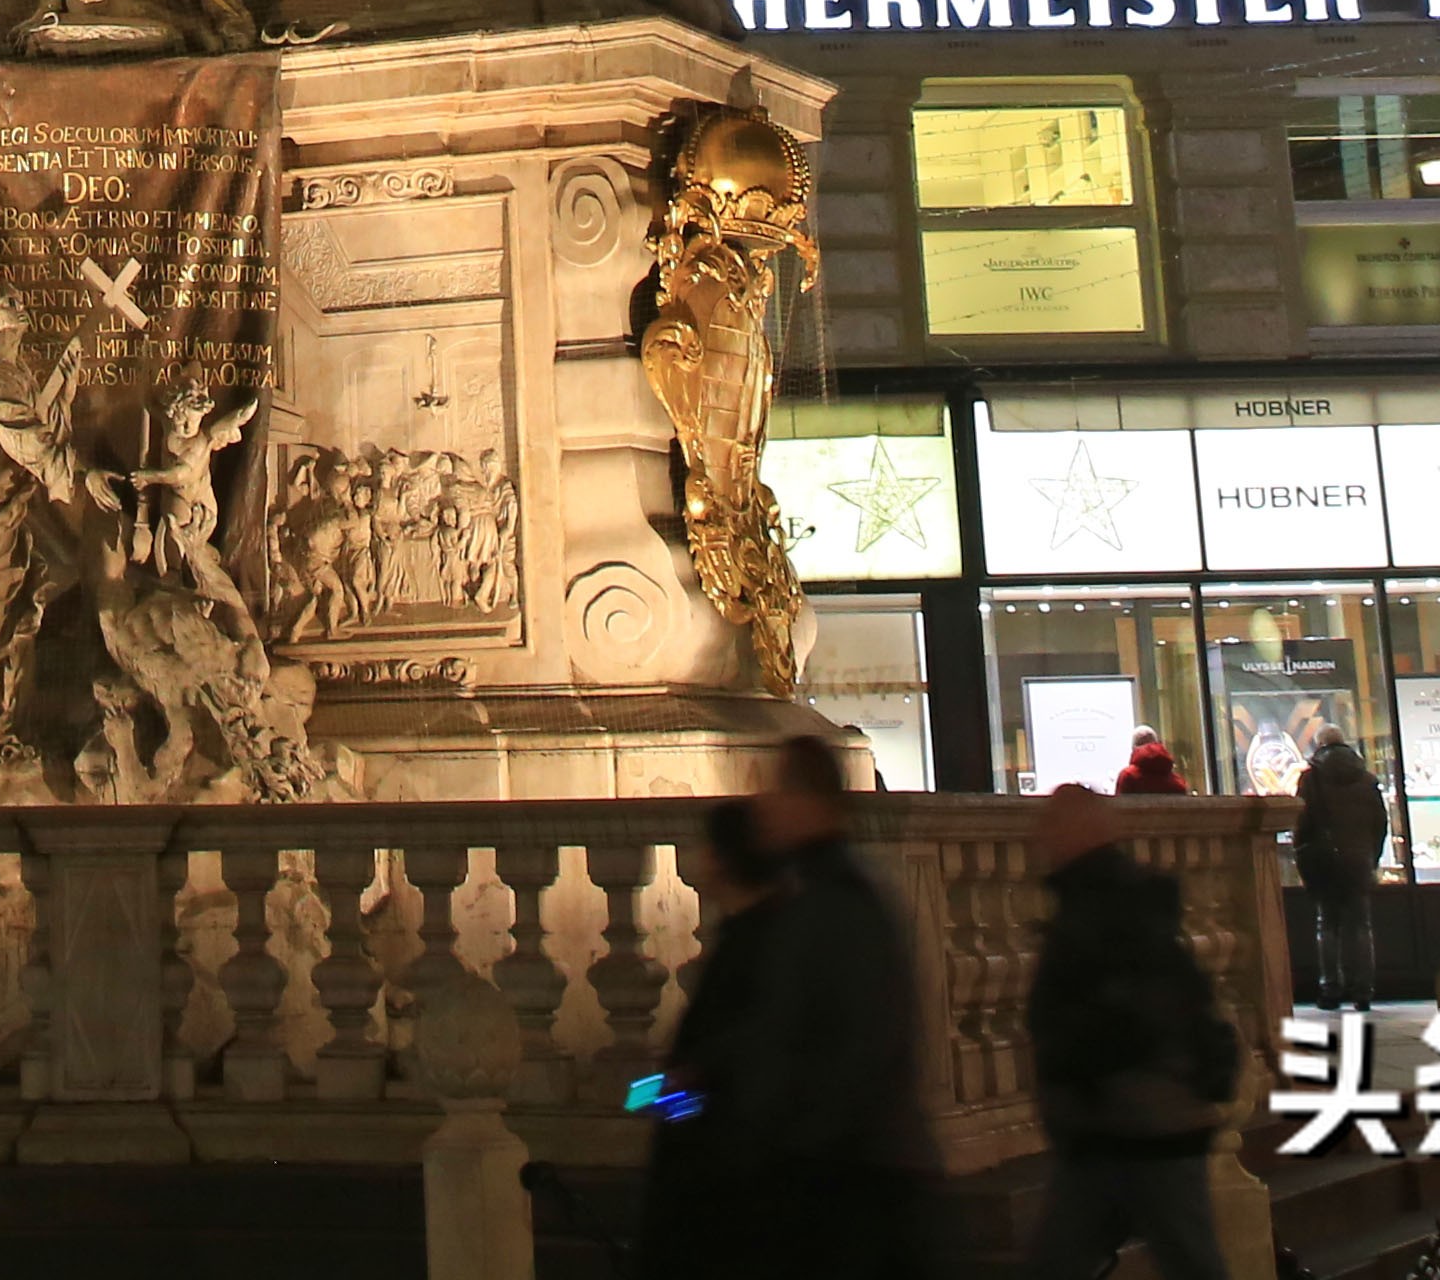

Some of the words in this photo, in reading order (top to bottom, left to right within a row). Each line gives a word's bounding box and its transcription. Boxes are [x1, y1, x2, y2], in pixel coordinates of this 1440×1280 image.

[66, 146, 94, 169] ET
[94, 146, 155, 170] TRINO
[158, 152, 177, 170] IN
[63, 171, 131, 204] DEO:
[1019, 286, 1054, 301] IWC
[1217, 484, 1368, 510] HÜBNER
[1241, 661, 1284, 672] ULYSSE
[1291, 659, 1336, 671] NARDIN
